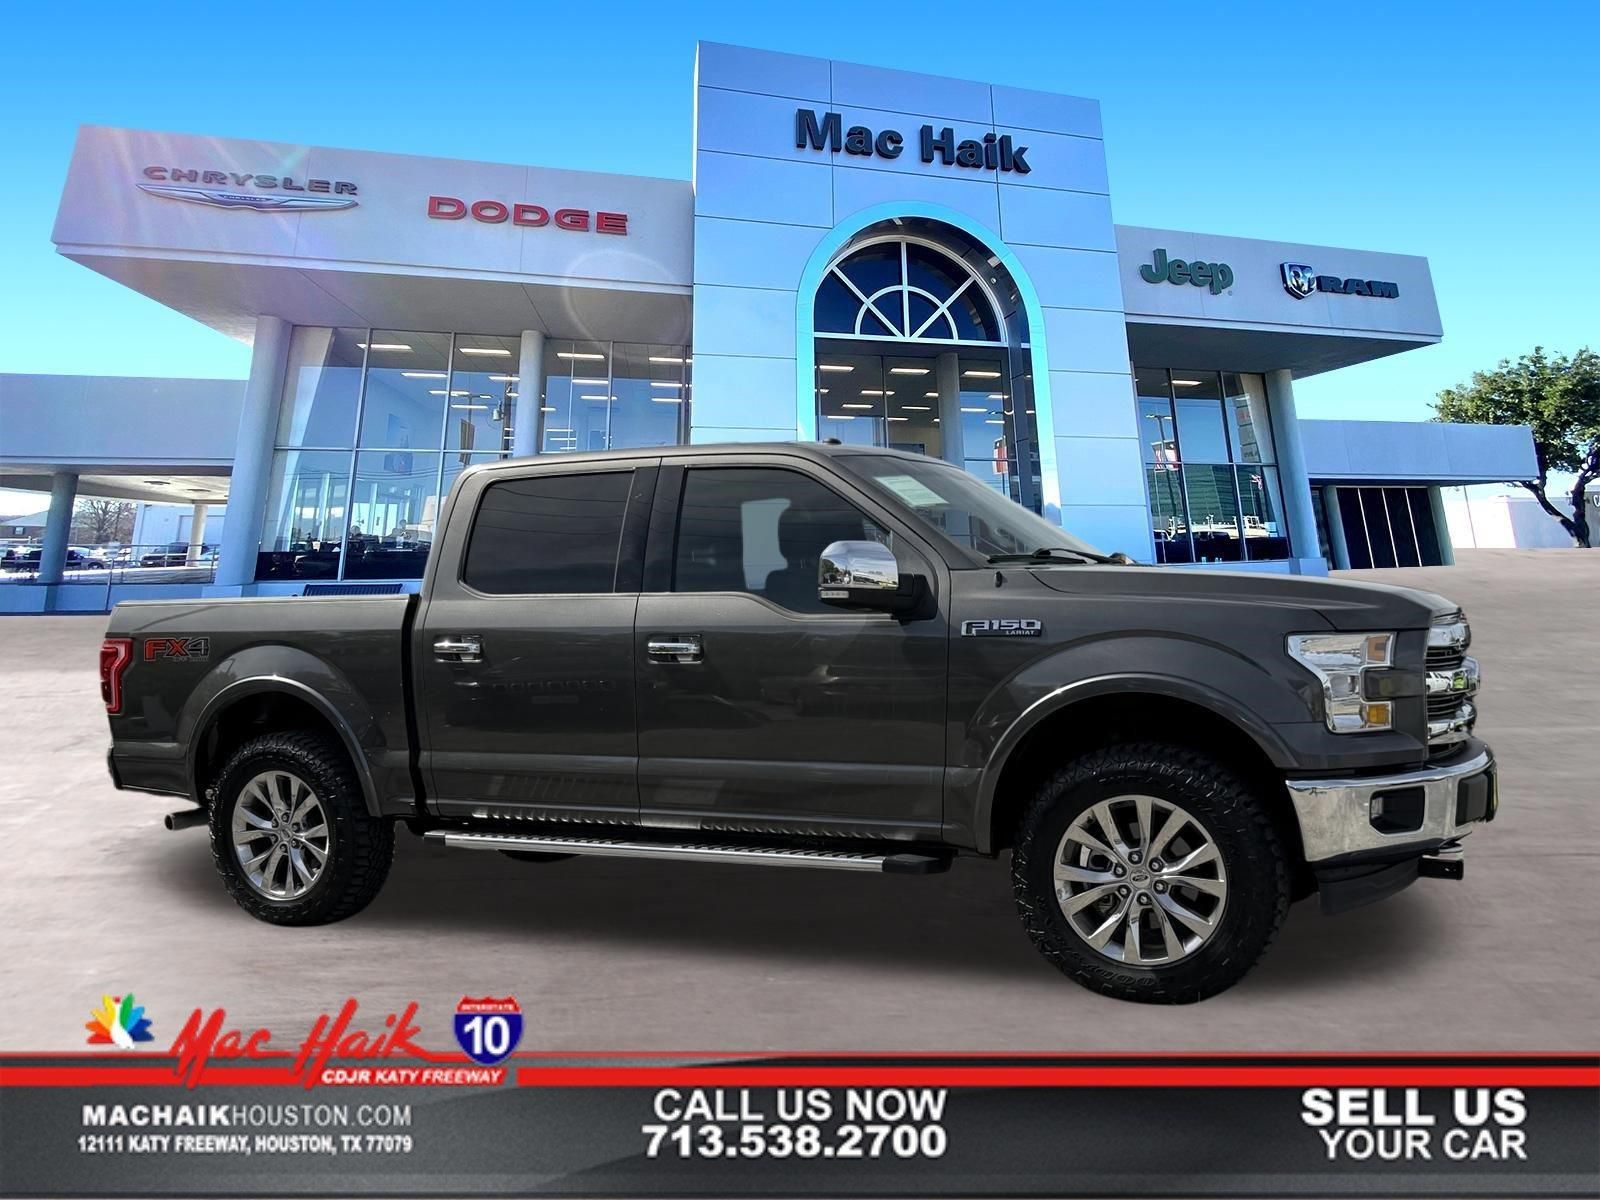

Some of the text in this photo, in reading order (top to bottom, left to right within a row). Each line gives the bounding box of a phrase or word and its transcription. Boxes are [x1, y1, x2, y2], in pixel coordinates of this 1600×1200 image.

[796, 108, 1032, 174] Mac Haik
[143, 166, 358, 196] CHRYSLER
[427, 195, 628, 236] DODGE
[1139, 248, 1234, 295] Jeep
[1316, 275, 1400, 299] RAM
[144, 637, 210, 661] FX4
